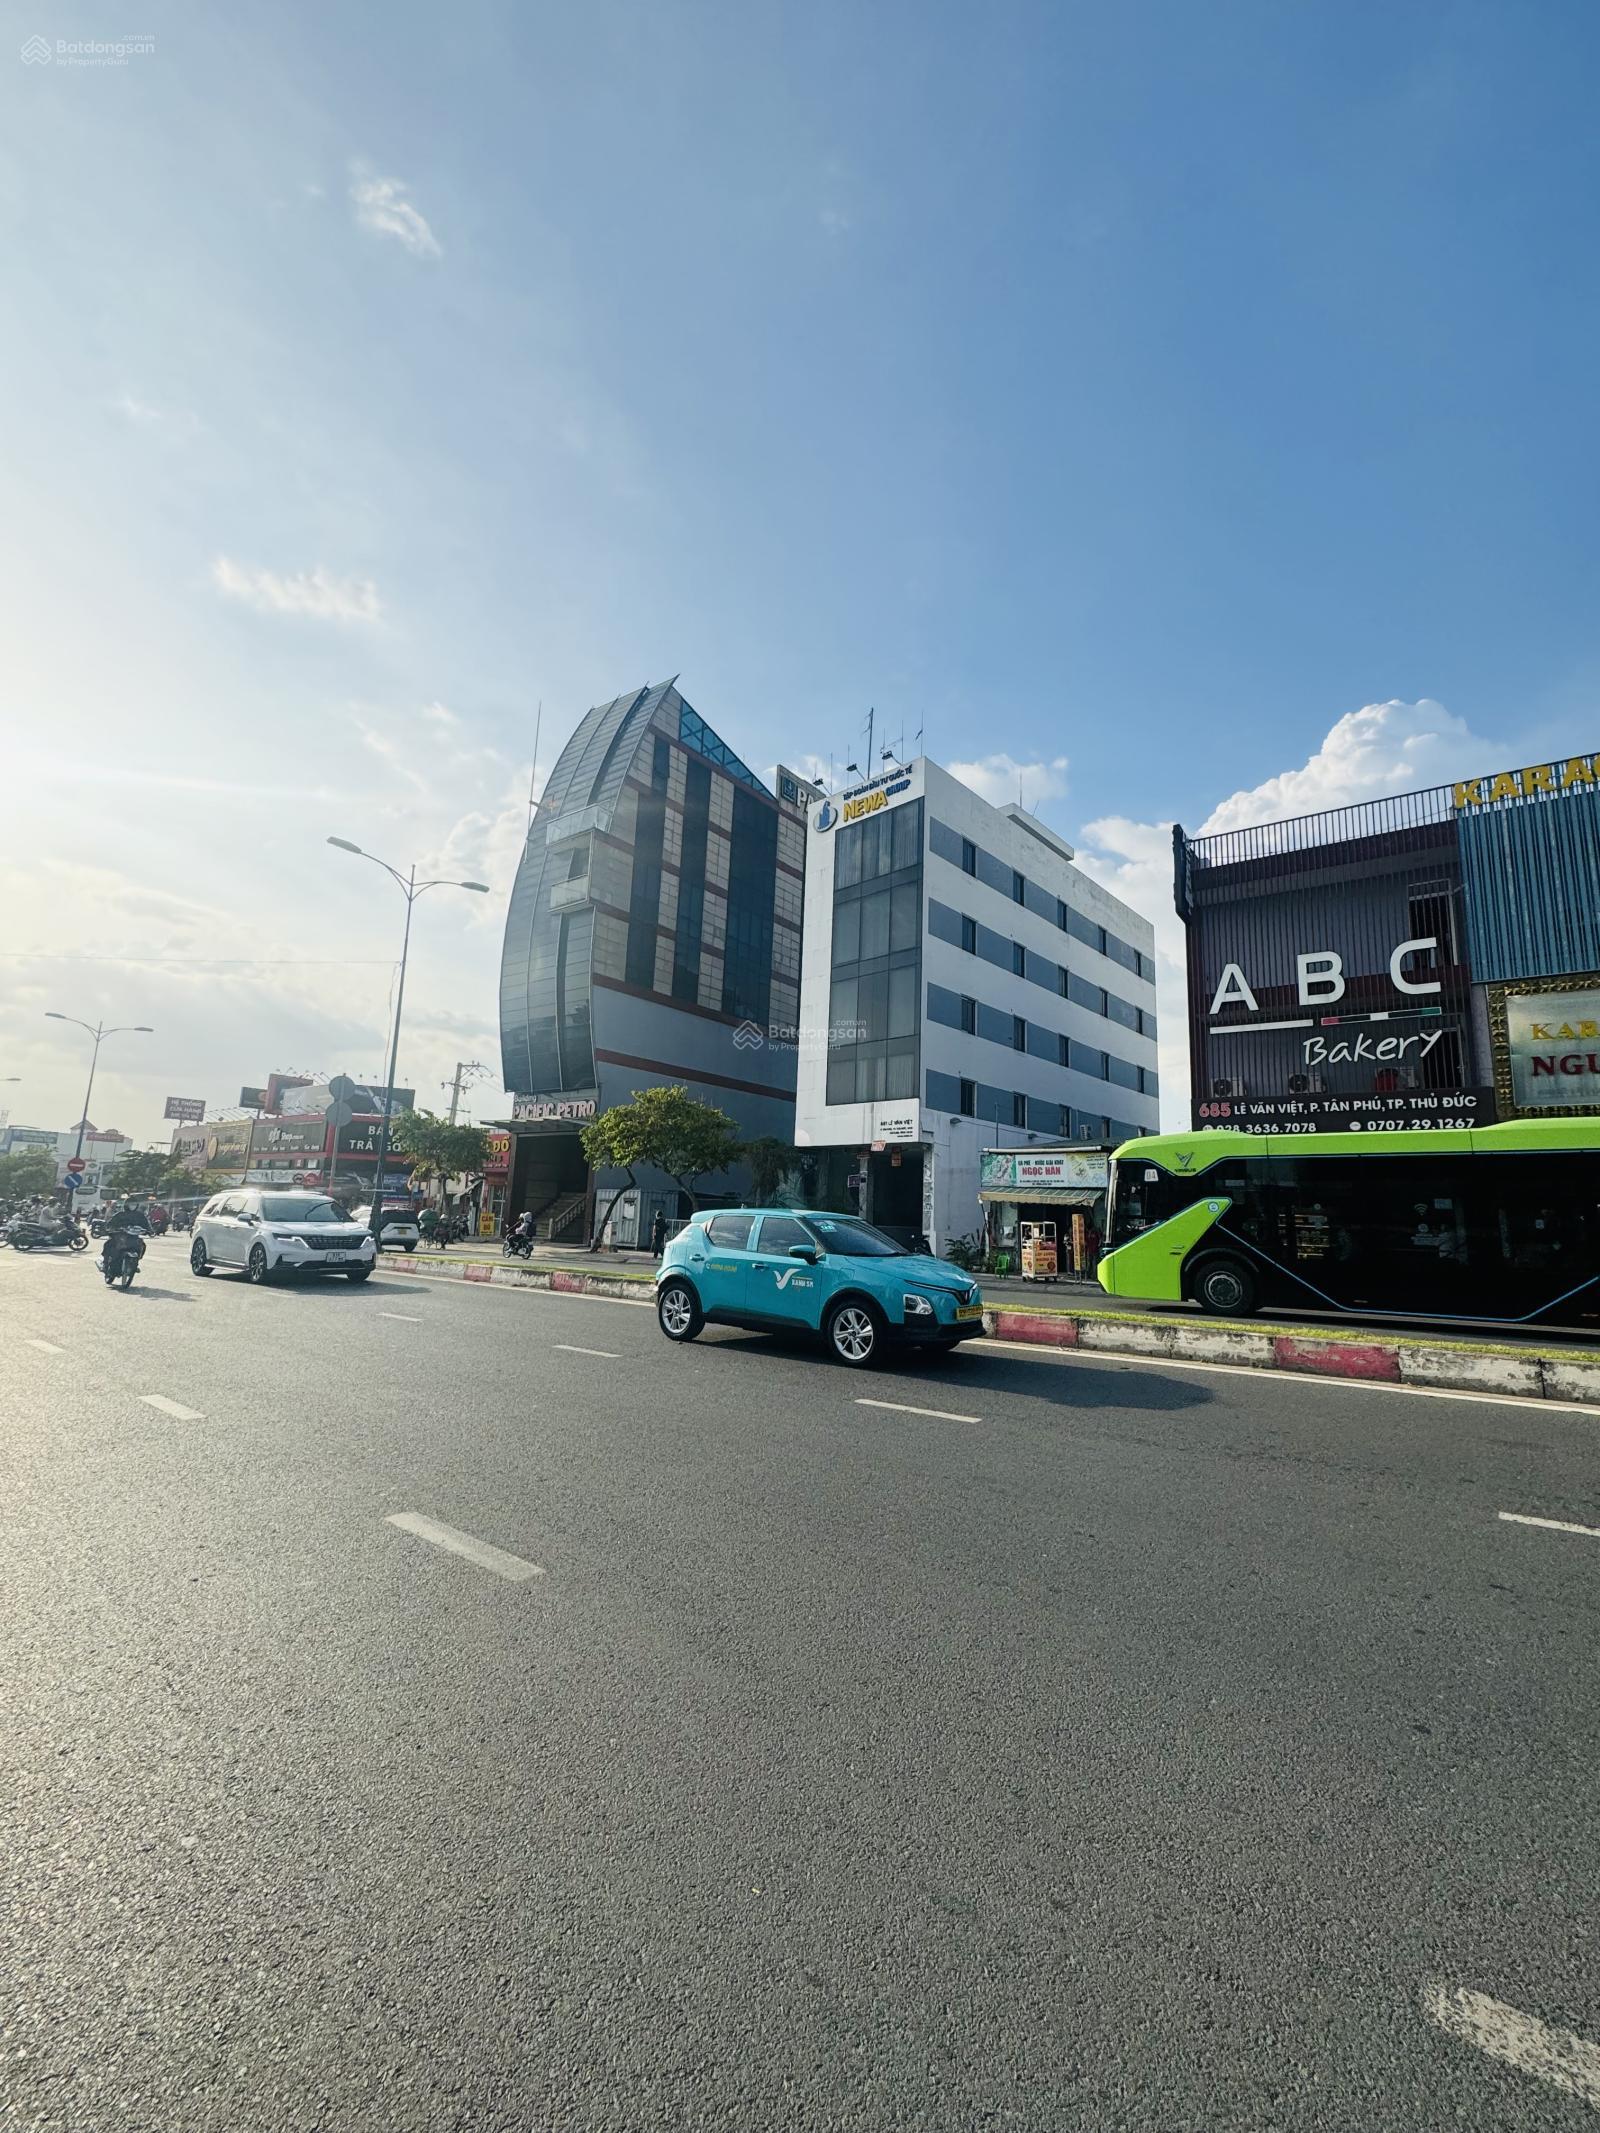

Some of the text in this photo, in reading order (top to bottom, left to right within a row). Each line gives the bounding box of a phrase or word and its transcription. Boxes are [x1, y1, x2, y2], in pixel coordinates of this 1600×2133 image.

[1454, 753, 1600, 808] KARA
[843, 778, 911, 822] NEWA GROUP
[1530, 1020, 1600, 1041] KAR
[1303, 1029, 1443, 1067] Bakery
[557, 1100, 596, 1118] PETRO
[1199, 1102, 1231, 1118] 685
[1234, 1101, 1247, 1115] LÊ
[1249, 1100, 1275, 1115] VĂN
[1277, 1099, 1308, 1117] VIỆT,
[1310, 1102, 1321, 1113] P.
[1323, 1099, 1350, 1113] TÂN
[1409, 1092, 1438, 1109] THỦ
[1442, 1092, 1478, 1108] ĐỨC
[1367, 1118, 1476, 1132] 0707.29.1267
[1022, 1166, 1043, 1177] NGỌC
